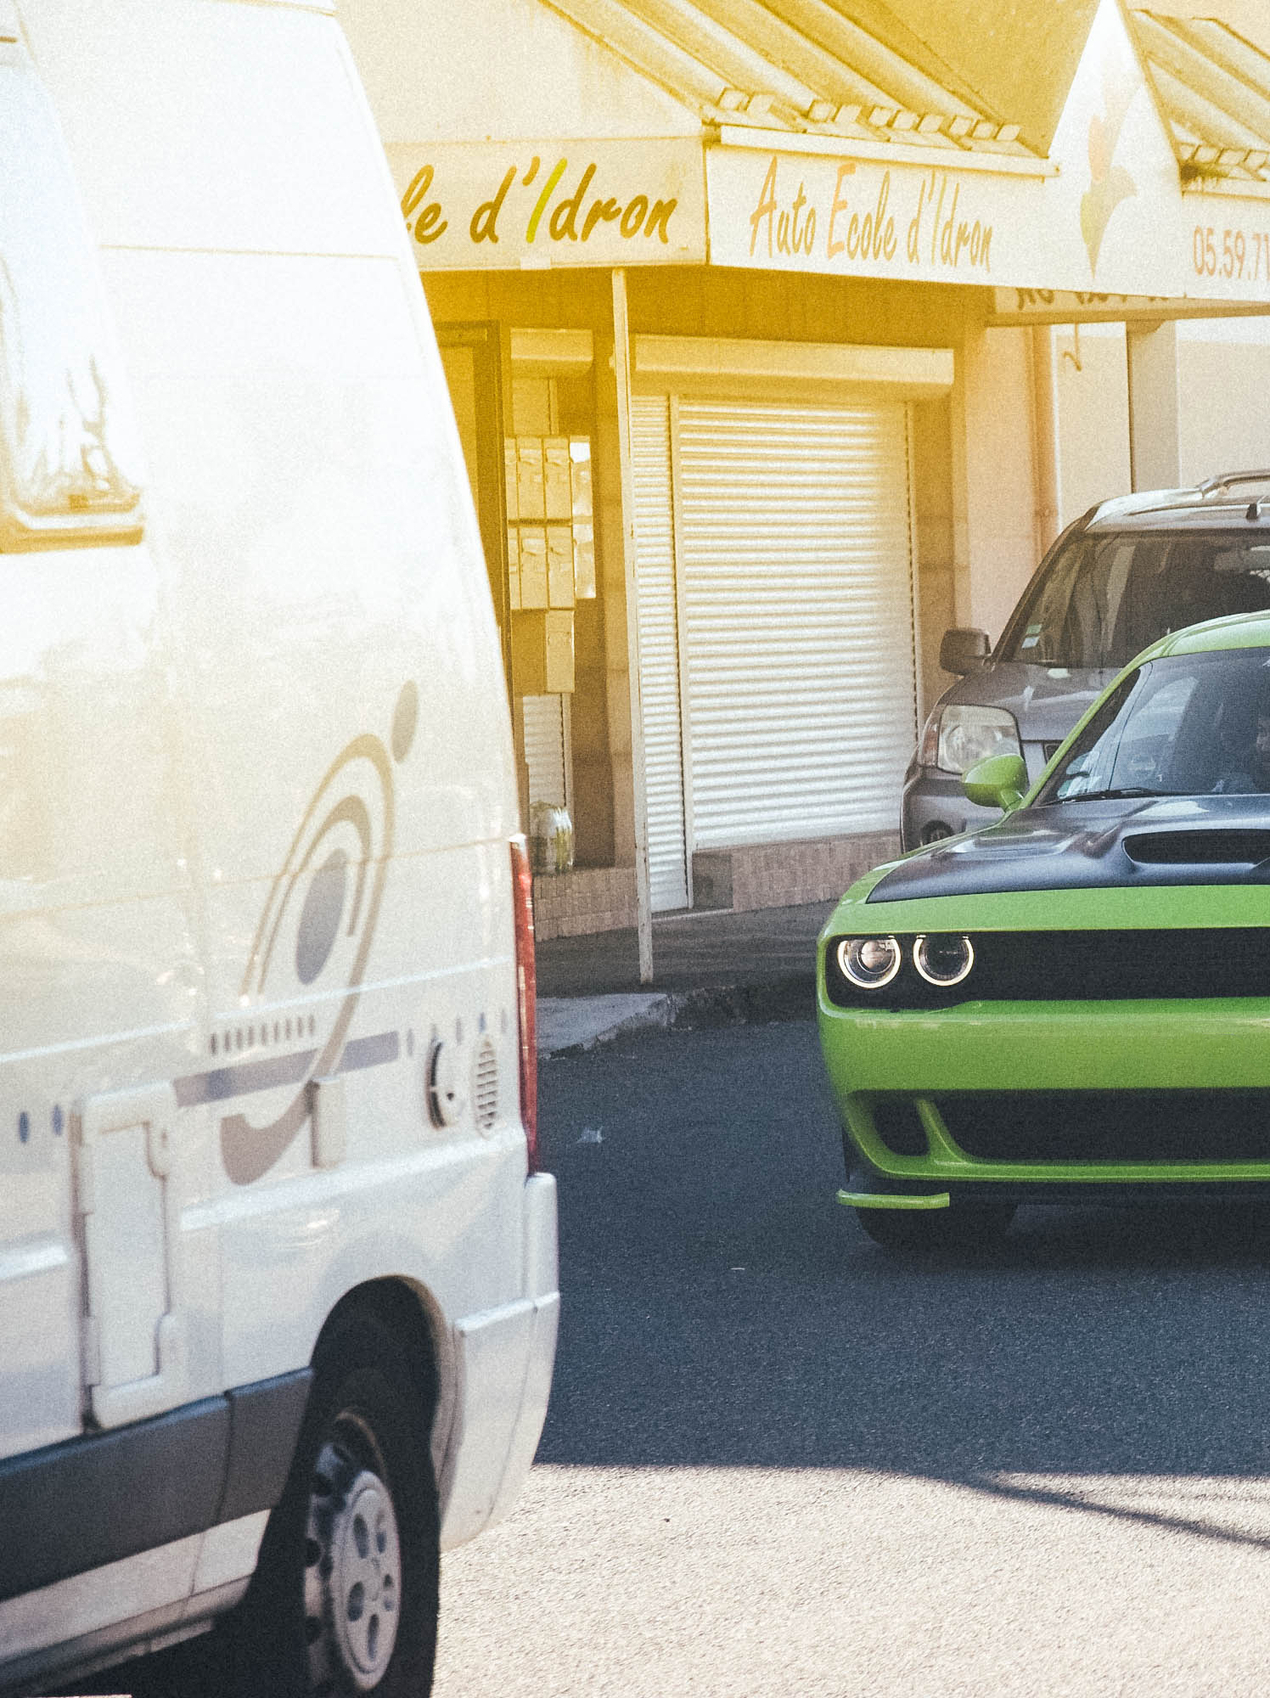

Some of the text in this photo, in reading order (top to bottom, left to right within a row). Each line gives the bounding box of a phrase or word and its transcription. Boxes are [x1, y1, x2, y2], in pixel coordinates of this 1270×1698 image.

[469, 155, 679, 244] d'Idron
[749, 155, 994, 274] Auto Ecole d'Idron
